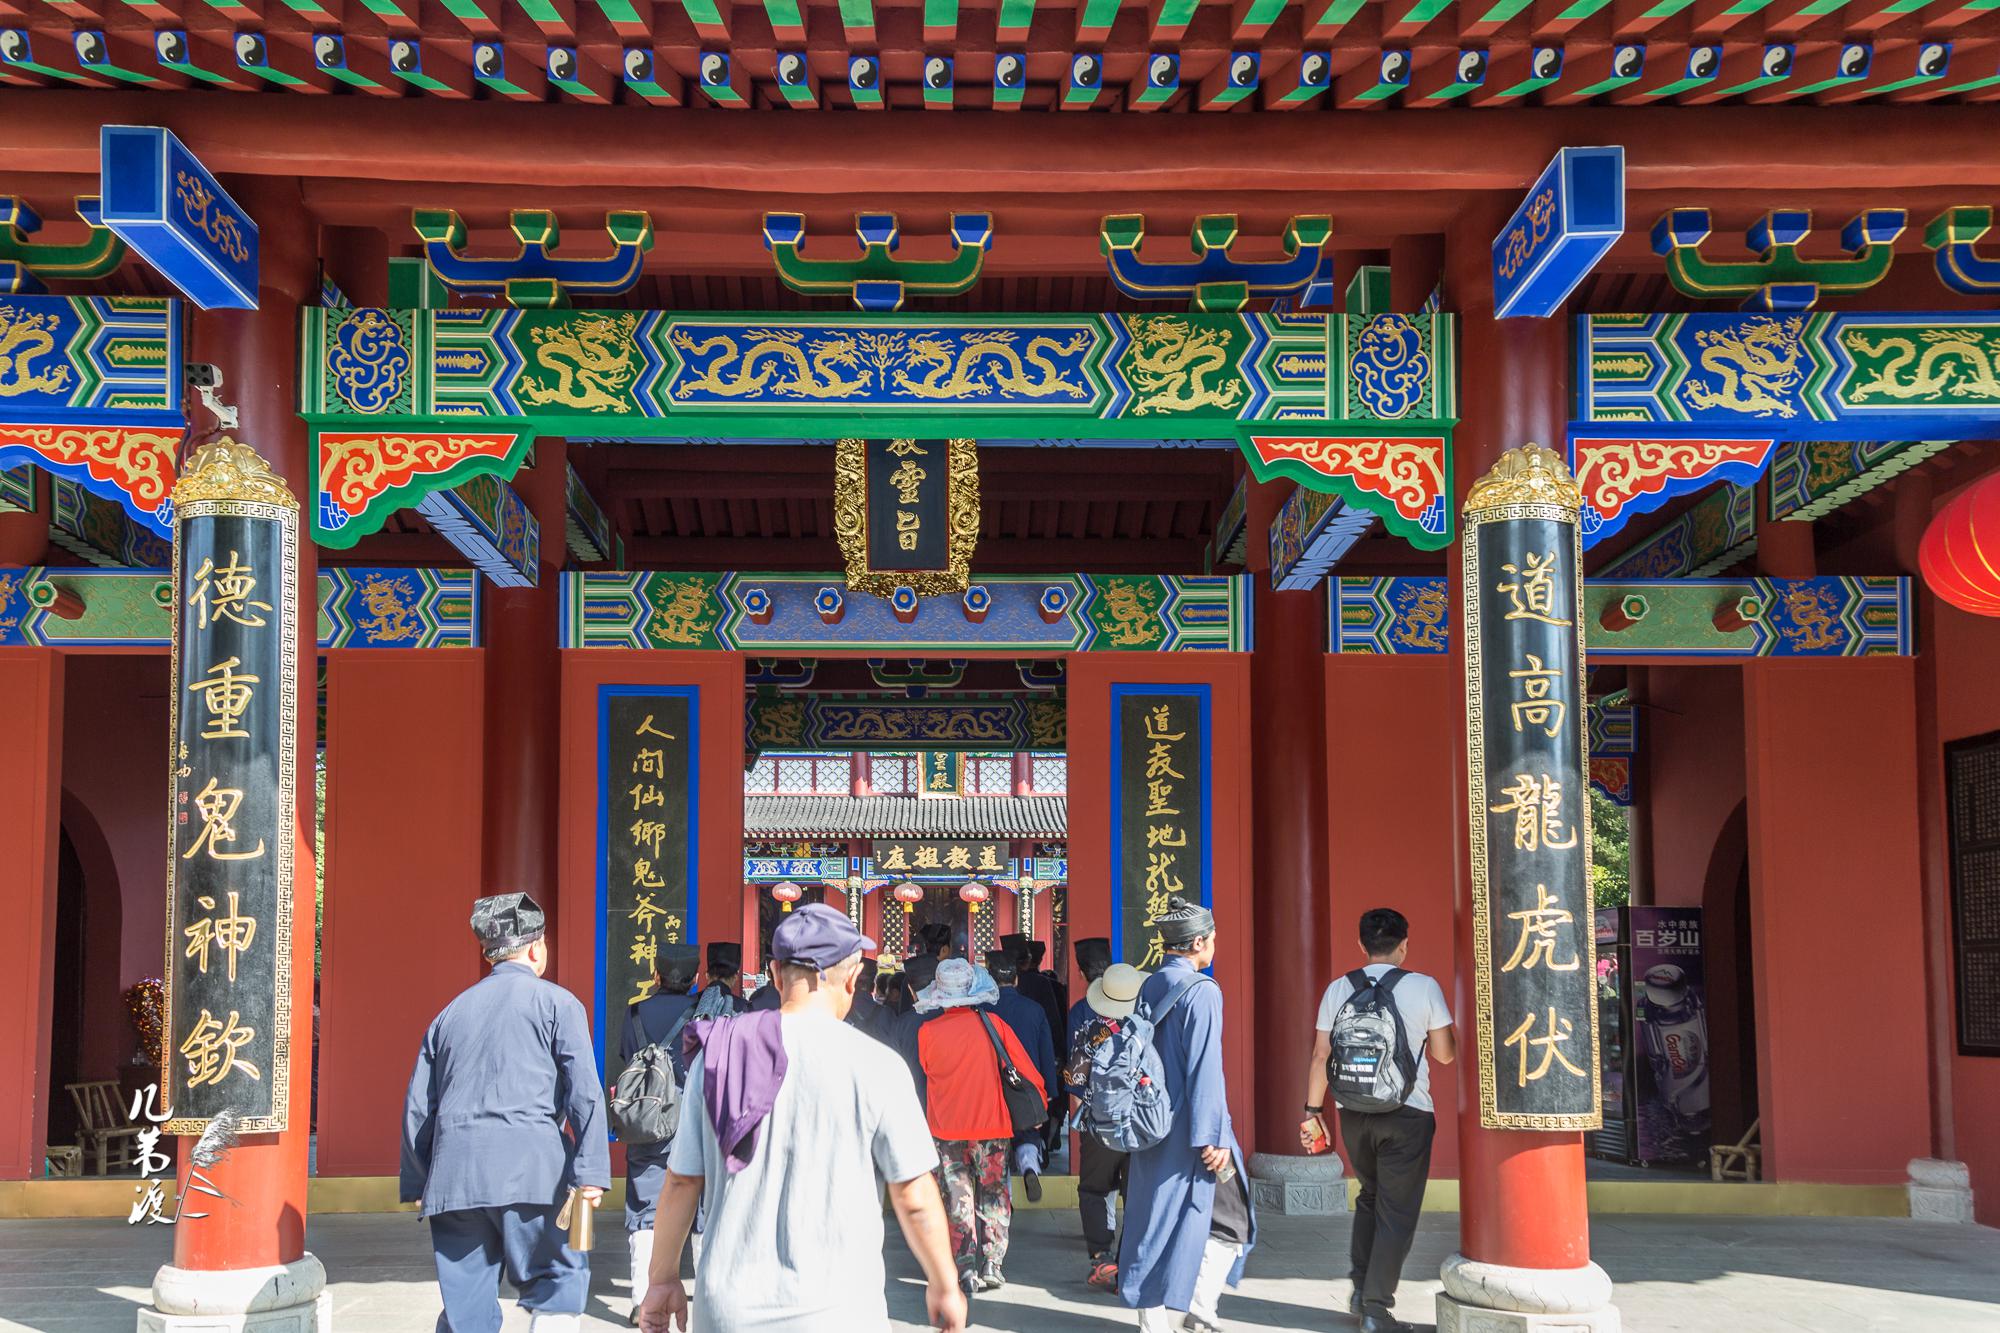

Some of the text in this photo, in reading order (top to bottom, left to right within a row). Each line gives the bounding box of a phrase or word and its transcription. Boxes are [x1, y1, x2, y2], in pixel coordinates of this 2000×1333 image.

[180, 550, 274, 1090] 德重鬼神欽
[882, 845, 1004, 870] 道教祖庭
[1490, 551, 1586, 1088] 道高龍虎伏
[1635, 930, 1699, 947] 百岁山
